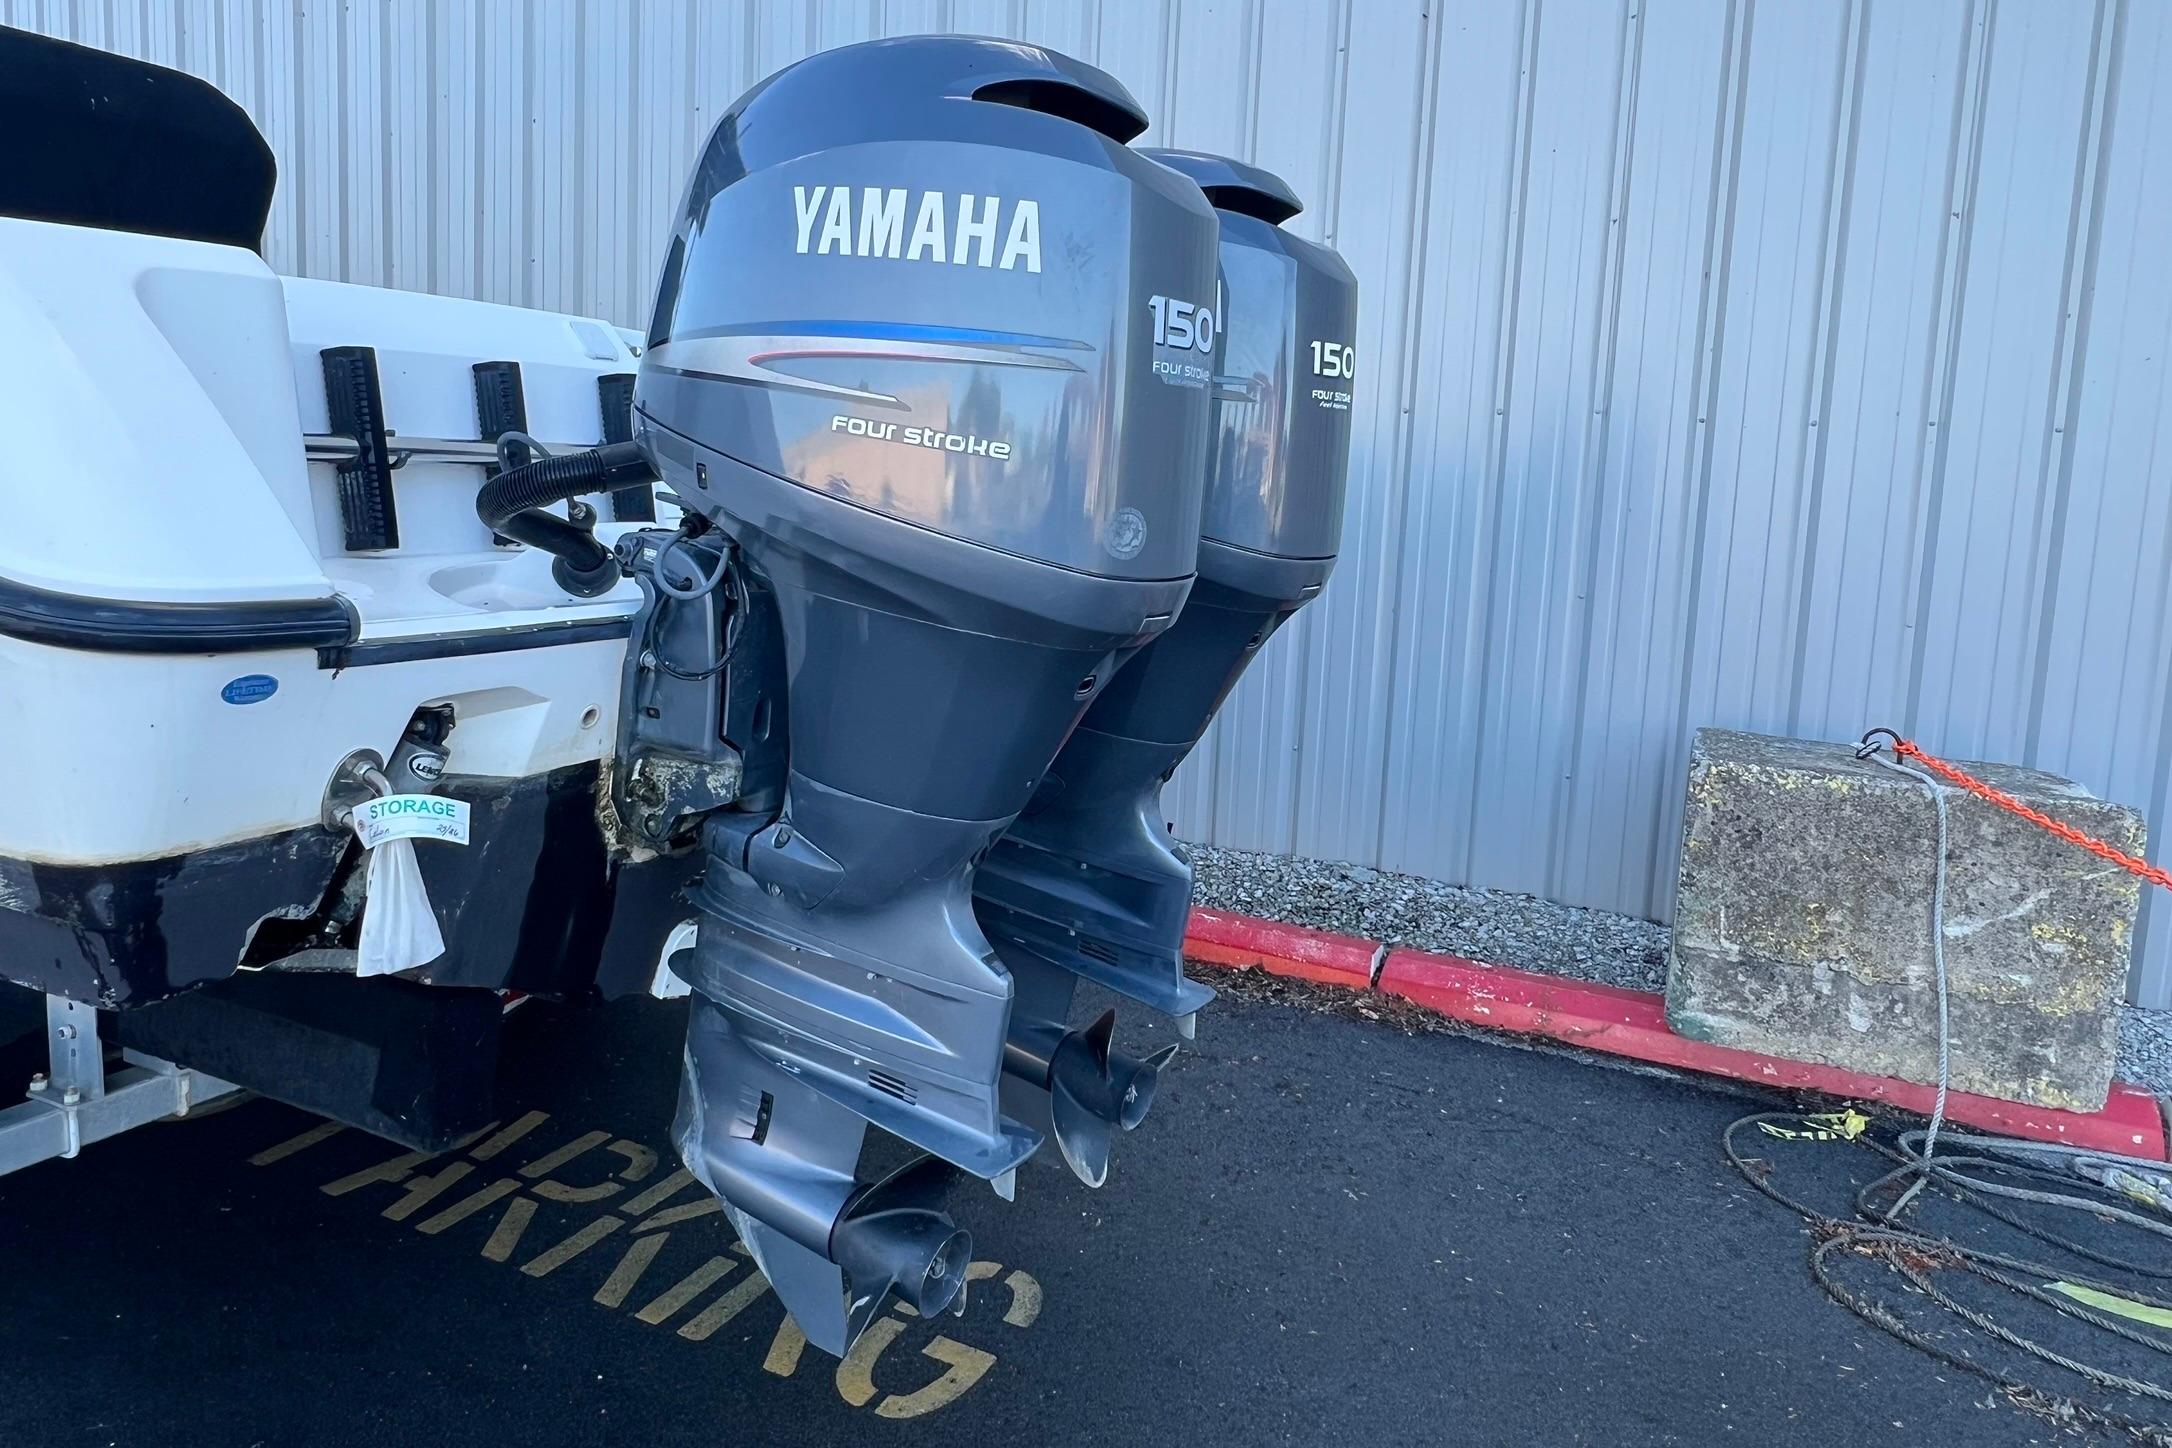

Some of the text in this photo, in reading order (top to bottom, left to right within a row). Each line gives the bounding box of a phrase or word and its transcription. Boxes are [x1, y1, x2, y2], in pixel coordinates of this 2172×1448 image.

[793, 186, 1042, 274] YAMAHA
[1148, 295, 1214, 353] 150
[1310, 340, 1355, 379] 150
[831, 414, 1012, 461] Four stroke
[369, 799, 456, 820] STORAGE
[247, 1109, 1044, 1420] ARKIG
